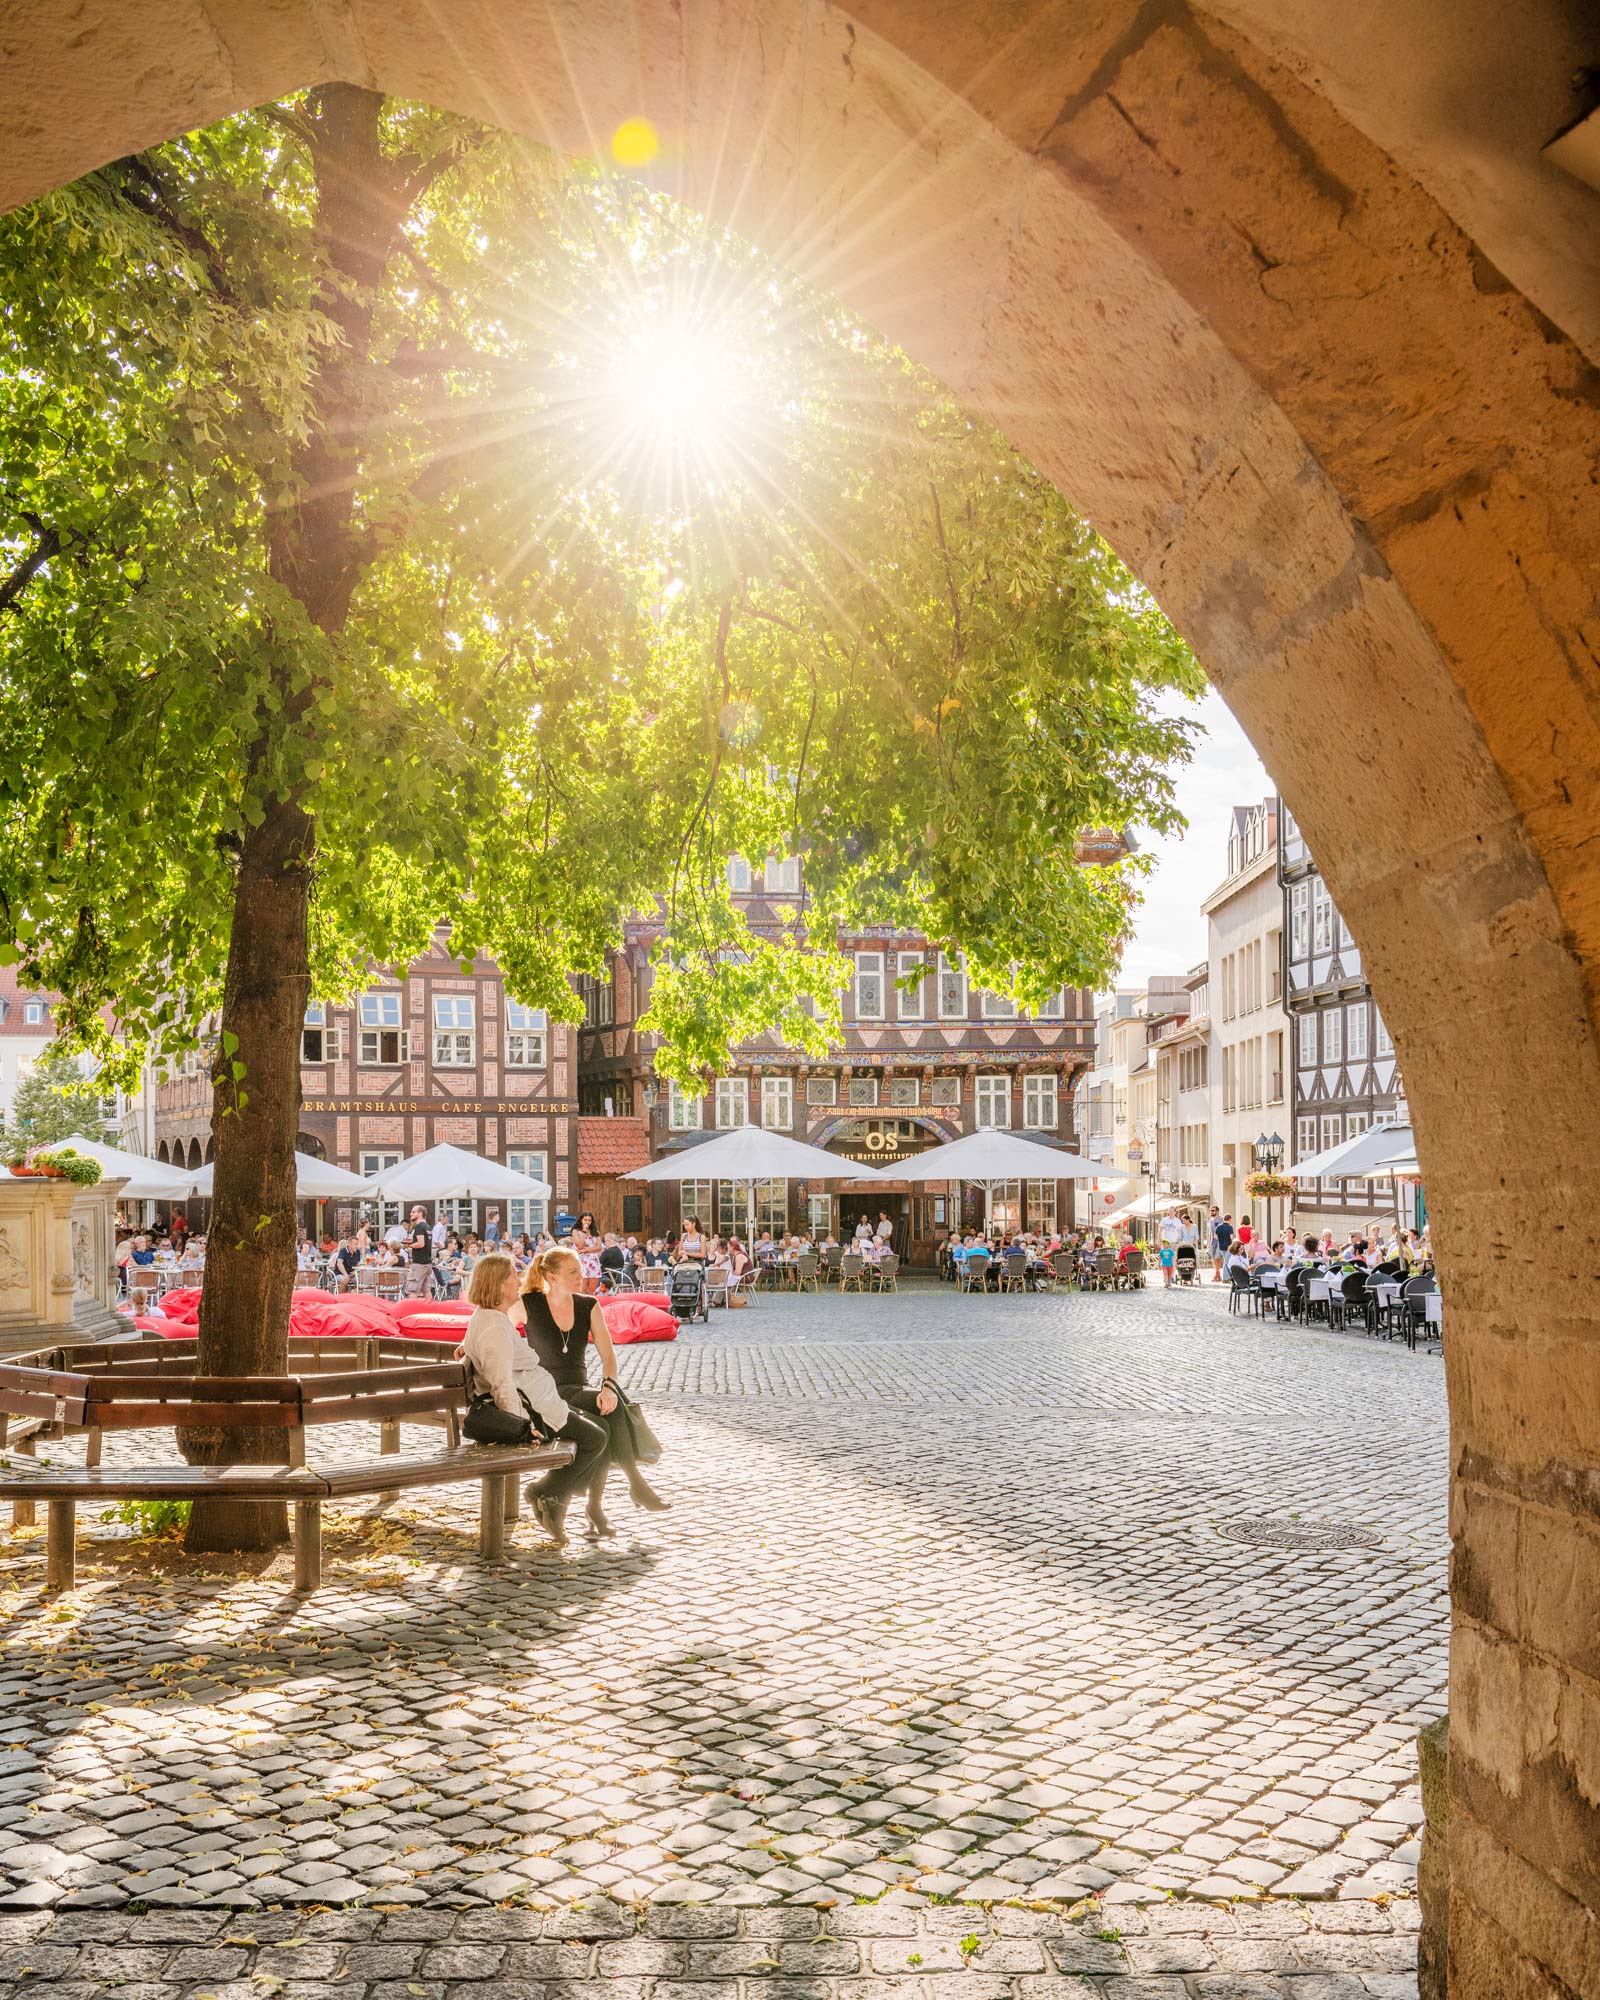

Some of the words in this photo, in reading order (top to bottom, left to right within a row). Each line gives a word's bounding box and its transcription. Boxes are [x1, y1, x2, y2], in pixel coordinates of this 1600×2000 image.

[301, 1101, 417, 1111] ERAMTSHAUS
[442, 1102, 481, 1113] CAFE
[498, 1103, 569, 1113] ENGELKE
[865, 1132, 898, 1151] OS
